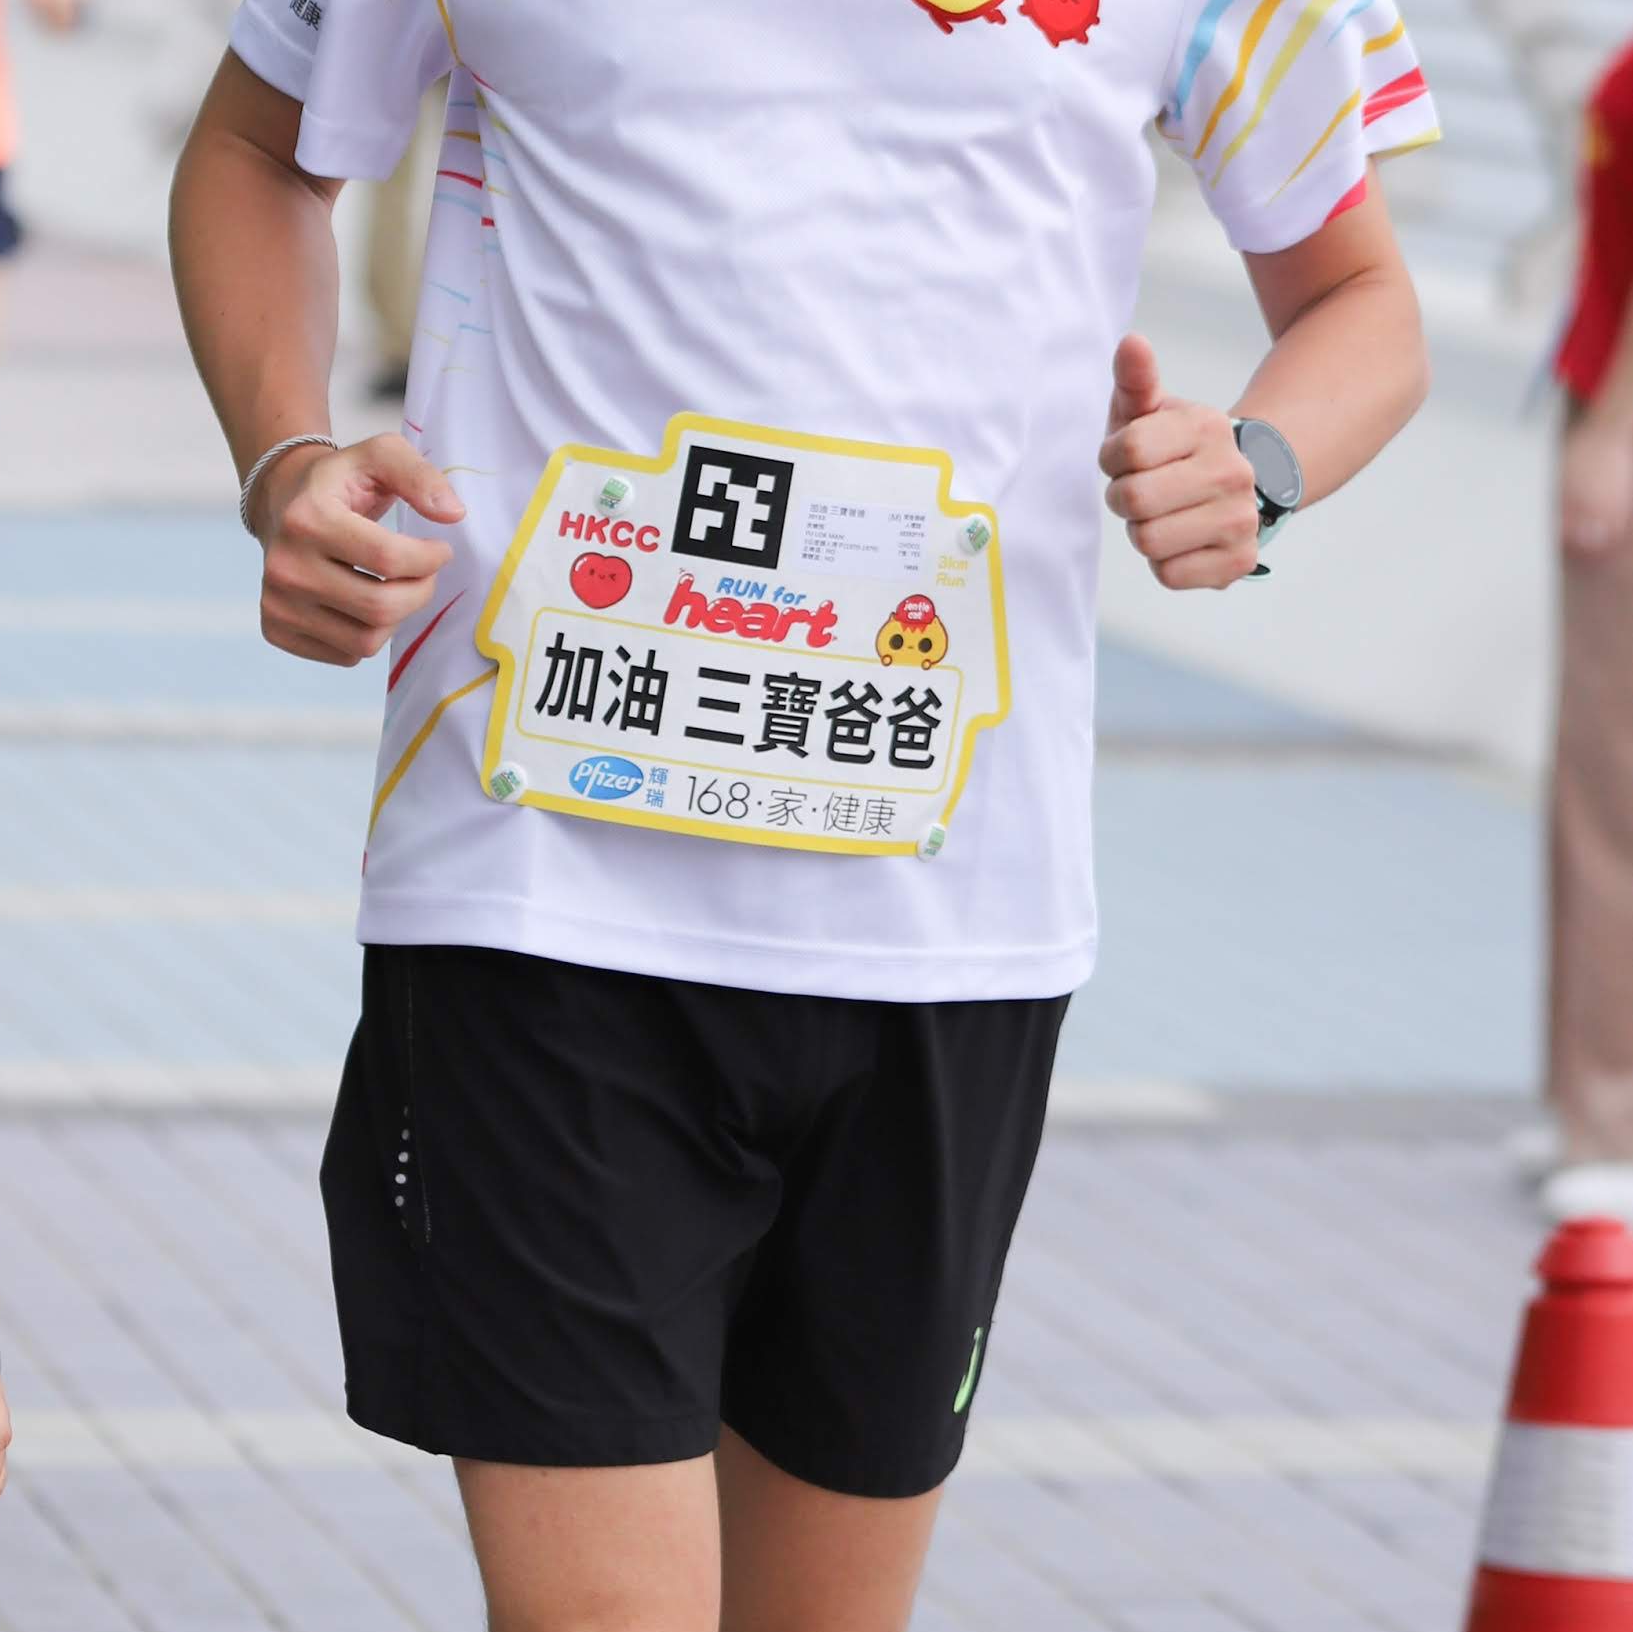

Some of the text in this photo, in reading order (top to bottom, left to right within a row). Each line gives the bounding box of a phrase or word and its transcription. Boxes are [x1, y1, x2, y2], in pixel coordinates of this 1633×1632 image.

[559, 511, 661, 553] HKCC
[663, 572, 839, 648] heart
[716, 576, 807, 605] RUN for
[534, 631, 944, 770] 加油 三寶爸爸
[574, 761, 643, 799] Pfizer
